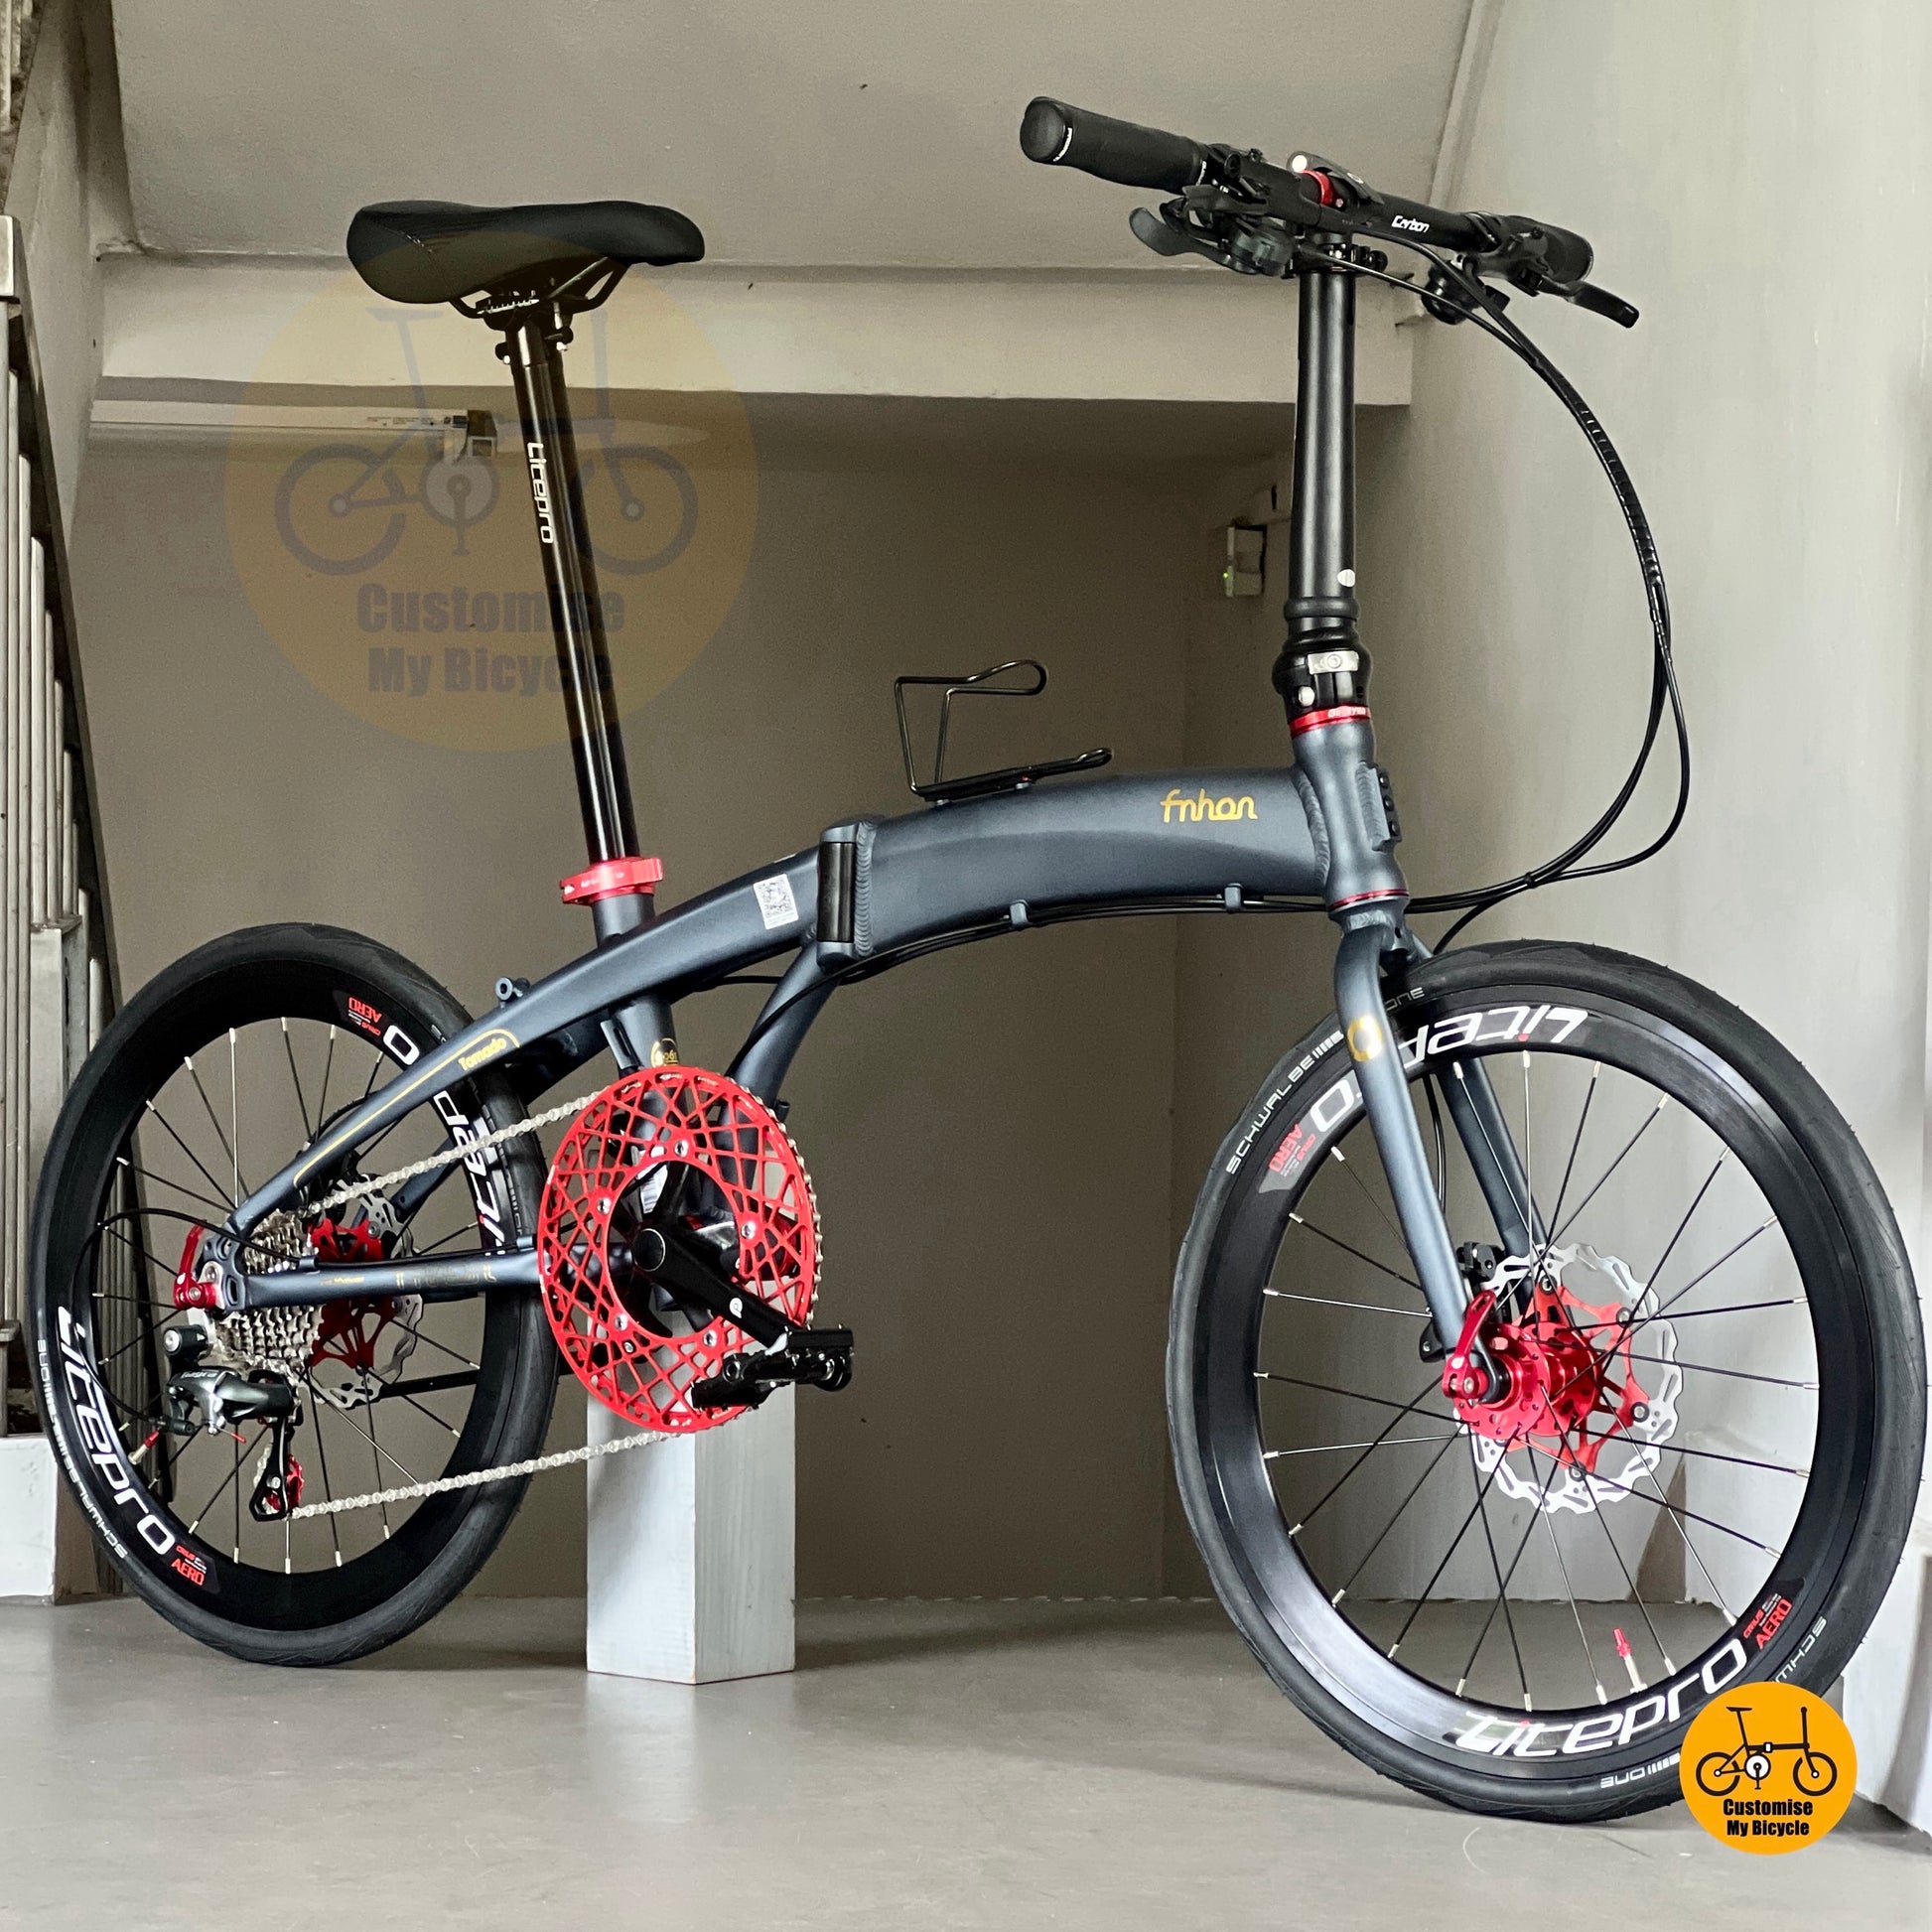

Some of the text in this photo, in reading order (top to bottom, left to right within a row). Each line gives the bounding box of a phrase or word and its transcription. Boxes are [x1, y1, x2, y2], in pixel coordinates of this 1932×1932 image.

[1391, 214, 1430, 232] Carbon
[527, 442, 553, 543] Litepro
[1160, 787, 1258, 823] fnhon
[348, 997, 382, 1022] AERO
[1226, 1052, 1315, 1174] SCHWALBE
[1269, 1123, 1304, 1173] AERO
[58, 1307, 175, 1555] Litepro
[62, 1456, 128, 1559] SCHWALBE
[171, 1559, 205, 1586] AERO
[1755, 1598, 1792, 1649] AERO
[1455, 1638, 1747, 1757] Litepro
